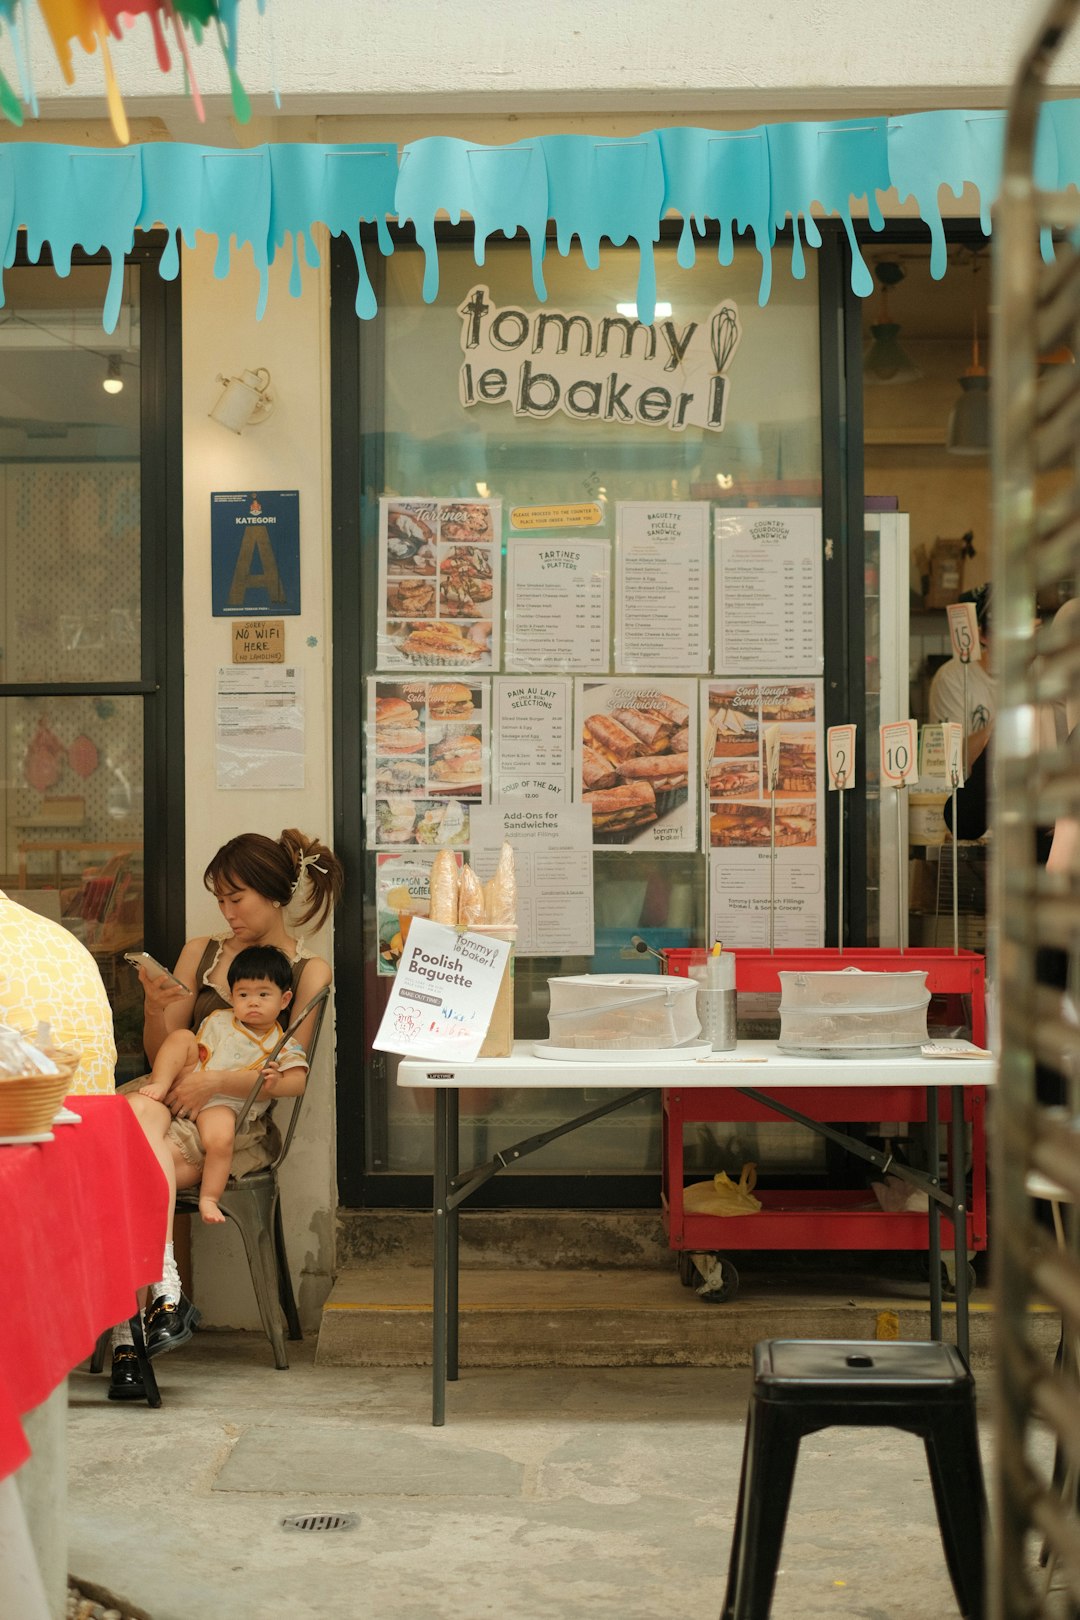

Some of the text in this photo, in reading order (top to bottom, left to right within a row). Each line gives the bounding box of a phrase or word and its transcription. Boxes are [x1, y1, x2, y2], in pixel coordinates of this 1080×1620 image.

[461, 290, 698, 372] tommy
[462, 360, 694, 428] le baker
[415, 508, 469, 521] Tartines
[229, 525, 287, 605] A
[547, 562, 577, 570] PLATTERS
[236, 629, 279, 640] NO WIFI
[955, 626, 970, 648] 15
[244, 642, 270, 652] HERE
[507, 689, 524, 698] PAIN
[541, 689, 557, 699] LAIT
[613, 688, 660, 700] Baguette
[736, 686, 788, 698] Sourdough
[512, 700, 553, 709] SELECTIONS
[607, 698, 668, 710] Sandwiches
[732, 696, 788, 706] Sandwiches
[836, 751, 846, 774] 2
[887, 746, 908, 770] 10
[502, 783, 519, 793] SOUP
[533, 781, 546, 789] THE
[548, 784, 562, 794] DAY
[504, 811, 558, 820] Add-Ons for
[504, 821, 558, 829] Sandwiches
[392, 877, 420, 885] LEMON
[457, 933, 493, 956] tommy
[412, 947, 463, 972] Poolish
[461, 948, 488, 966] baker
[409, 960, 473, 988] Baguette
